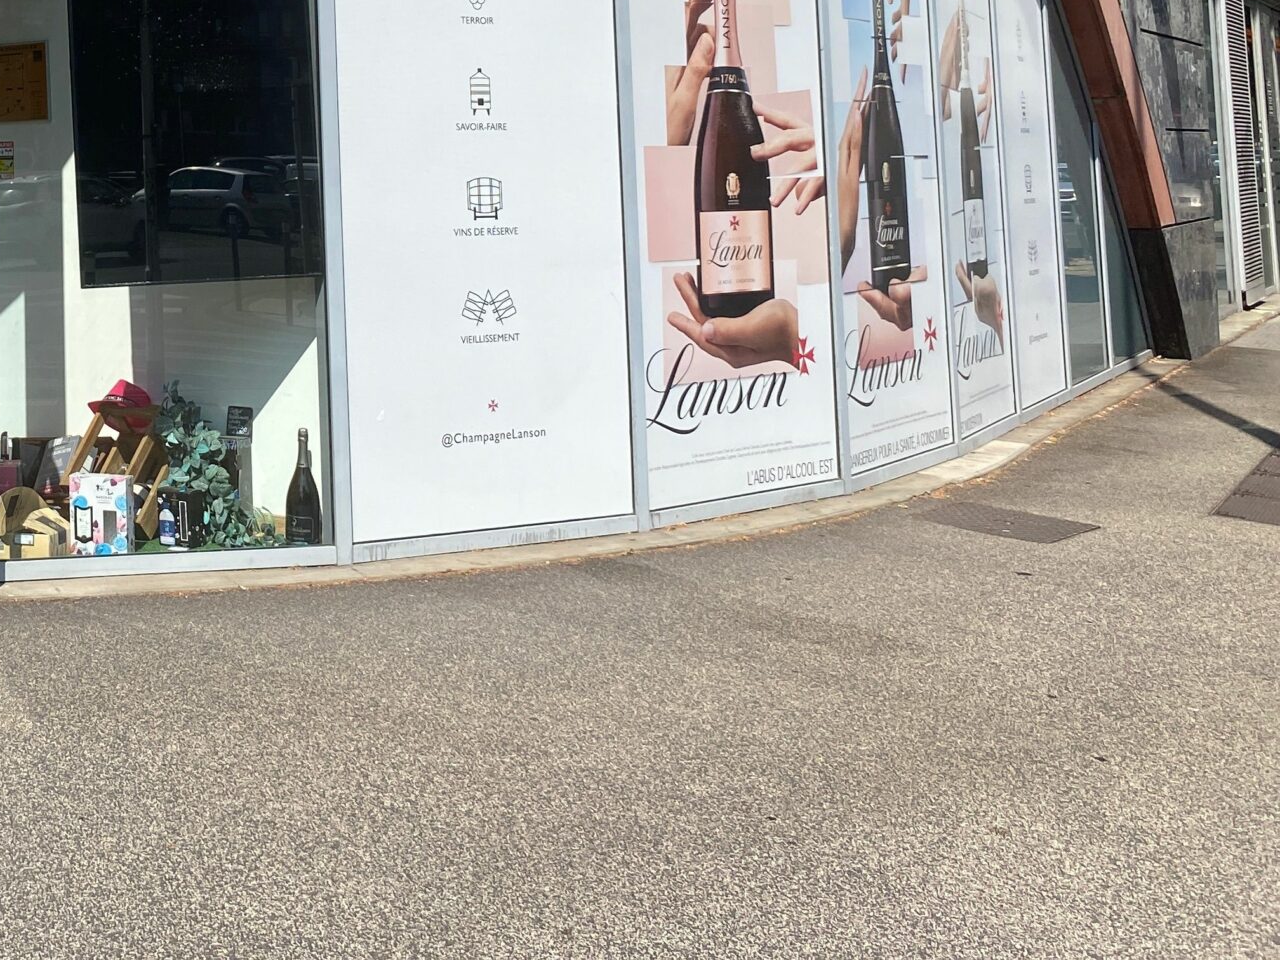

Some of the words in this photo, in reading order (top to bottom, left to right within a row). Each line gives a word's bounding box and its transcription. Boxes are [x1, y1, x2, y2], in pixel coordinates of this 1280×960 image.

[460, 16, 494, 25] TERROIR
[456, 122, 508, 131] SAVOIR-FAIRE
[453, 228, 472, 237] VINS
[474, 227, 485, 236] DE
[487, 226, 519, 236] RÉSERVE
[708, 230, 763, 268] Lanson
[460, 333, 520, 344] VIEILLISSEMENT
[845, 324, 924, 407] Lanson
[646, 343, 789, 435] Lanson
[442, 428, 546, 448] @ChampagneLanson
[746, 467, 776, 486] L'ABUS
[777, 461, 818, 481] D'ALCOOL
[819, 458, 834, 475] EST
